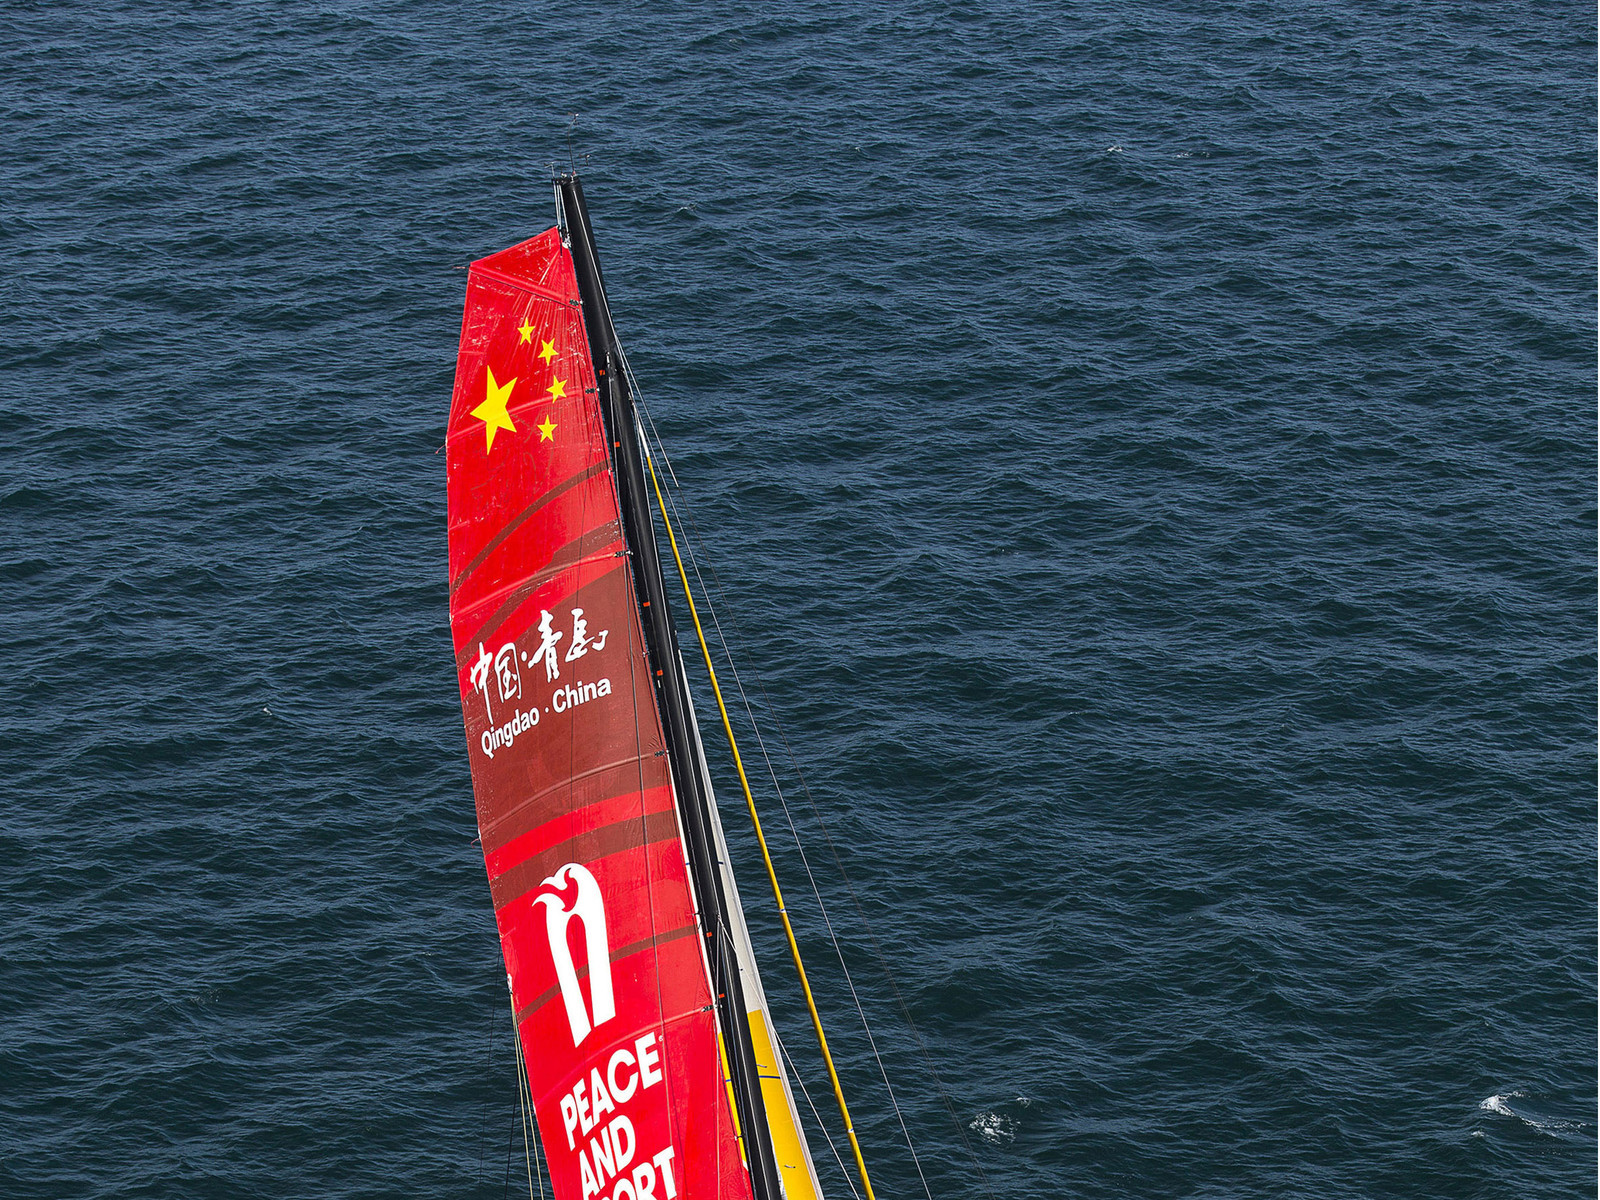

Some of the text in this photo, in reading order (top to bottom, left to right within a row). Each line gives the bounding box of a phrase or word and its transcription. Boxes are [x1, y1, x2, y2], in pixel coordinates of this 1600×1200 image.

[481, 678, 612, 759] Qingdao China
[560, 1032, 663, 1151] PEACE
